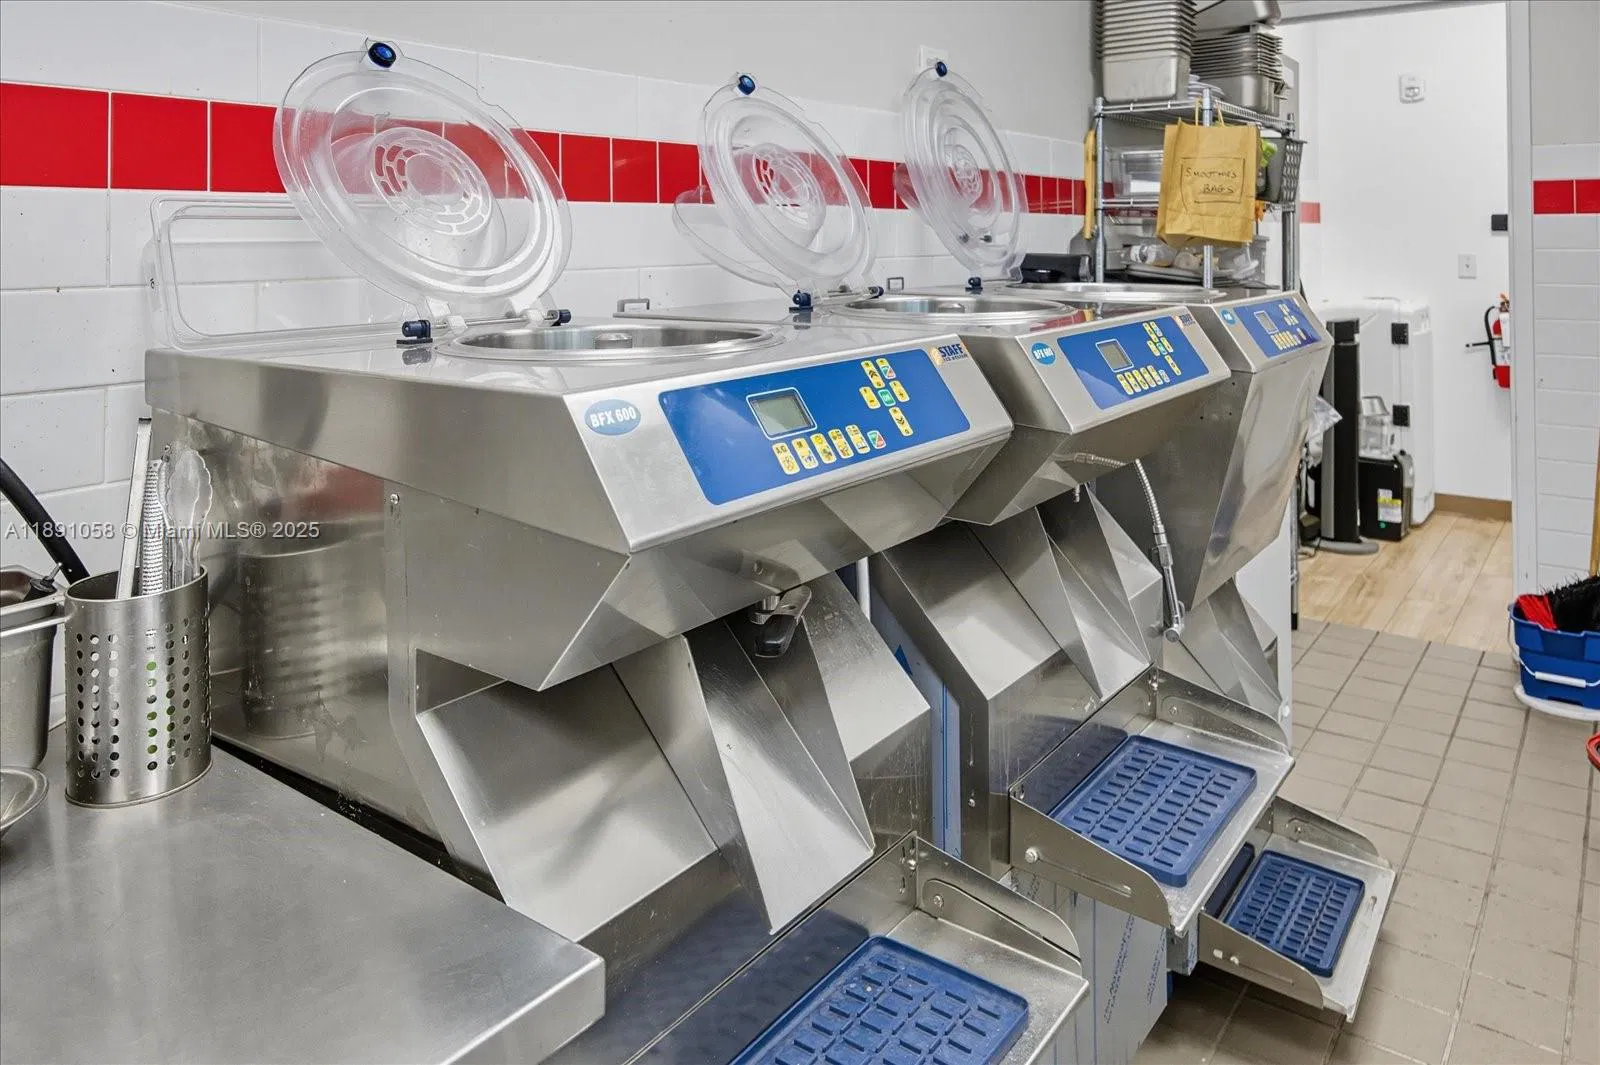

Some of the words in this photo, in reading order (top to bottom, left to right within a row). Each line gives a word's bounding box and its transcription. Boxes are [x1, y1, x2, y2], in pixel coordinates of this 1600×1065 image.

[938, 343, 963, 357] STAFF
[590, 410, 615, 428] BFX
[615, 406, 636, 422] 600
